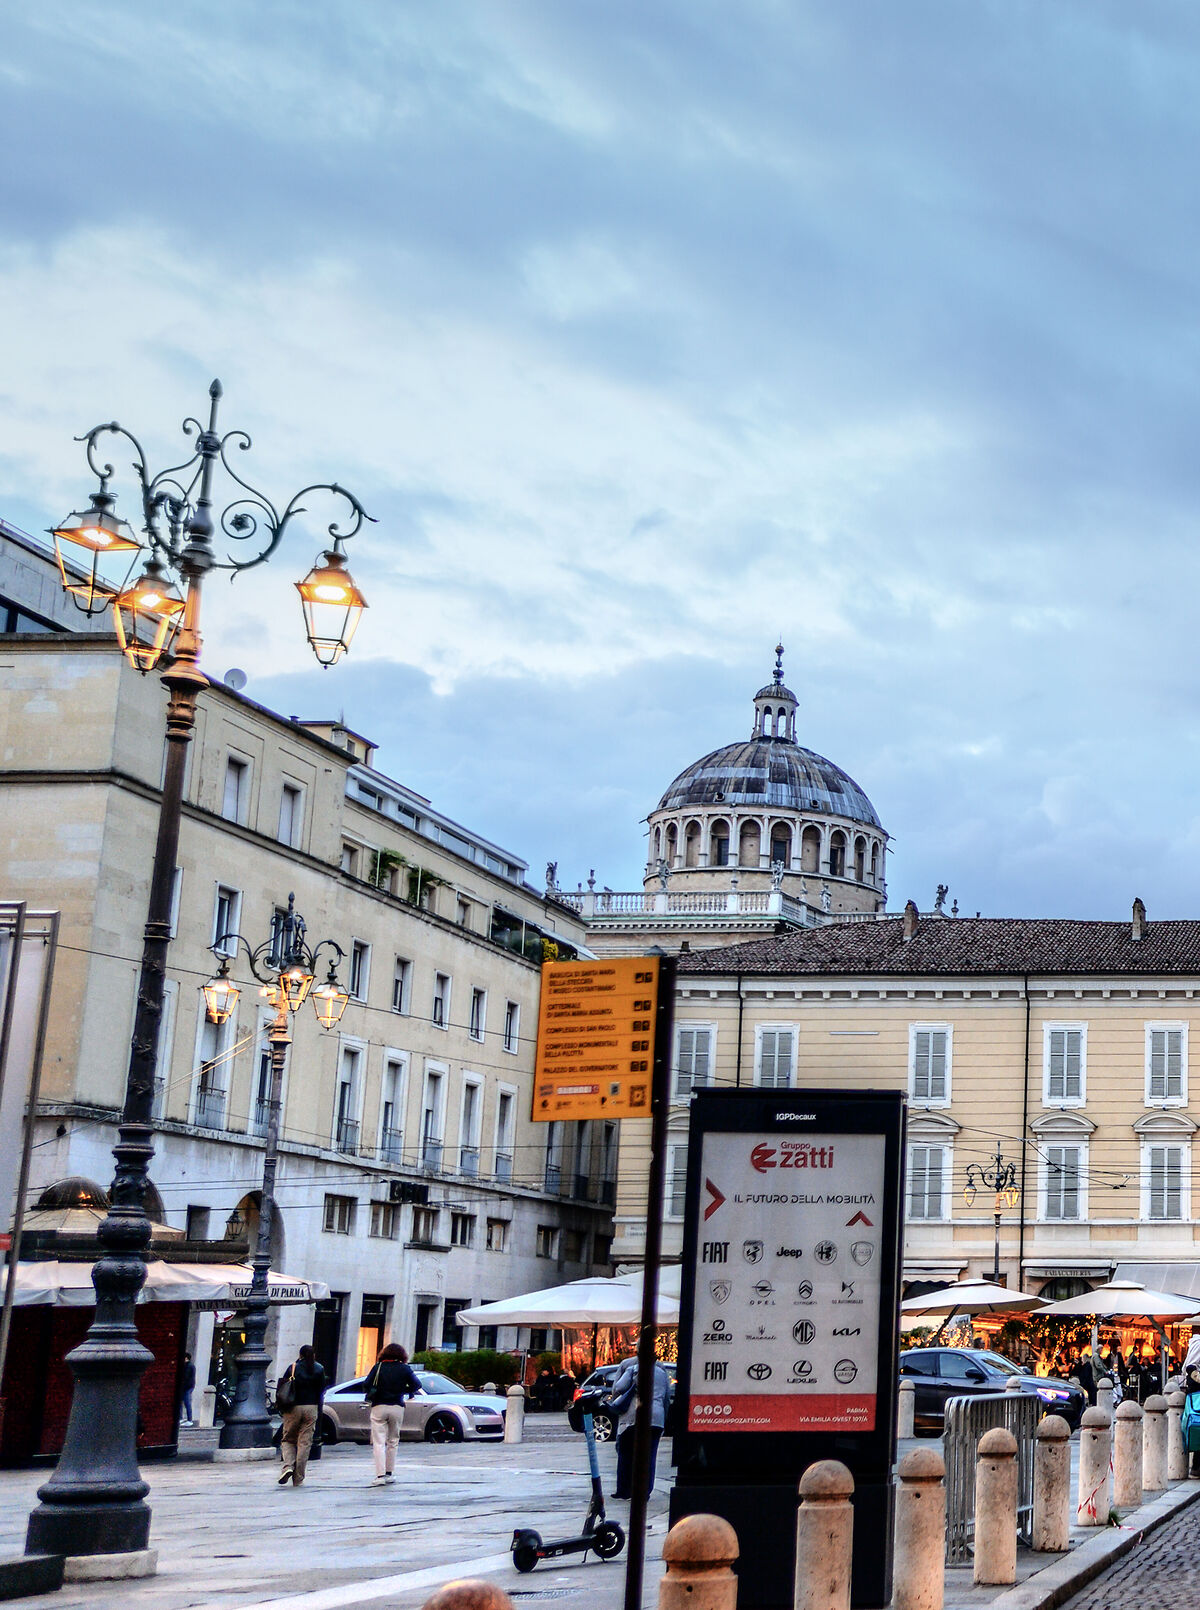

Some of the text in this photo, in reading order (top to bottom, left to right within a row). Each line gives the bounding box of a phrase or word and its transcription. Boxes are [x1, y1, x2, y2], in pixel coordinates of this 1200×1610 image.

[780, 1141, 811, 1151] Gruppo
[780, 1146, 834, 1169] zatti
[734, 1193, 875, 1204] IL FUTURO DELLA MOBILITÀ
[702, 1241, 731, 1264] FIAT
[776, 1247, 803, 1259] Jeep
[270, 1287, 280, 1298] DI
[280, 1287, 305, 1298] PARMA
[703, 1333, 733, 1342] ZERO
[795, 1321, 814, 1343] MG
[704, 1361, 729, 1381] FIAT
